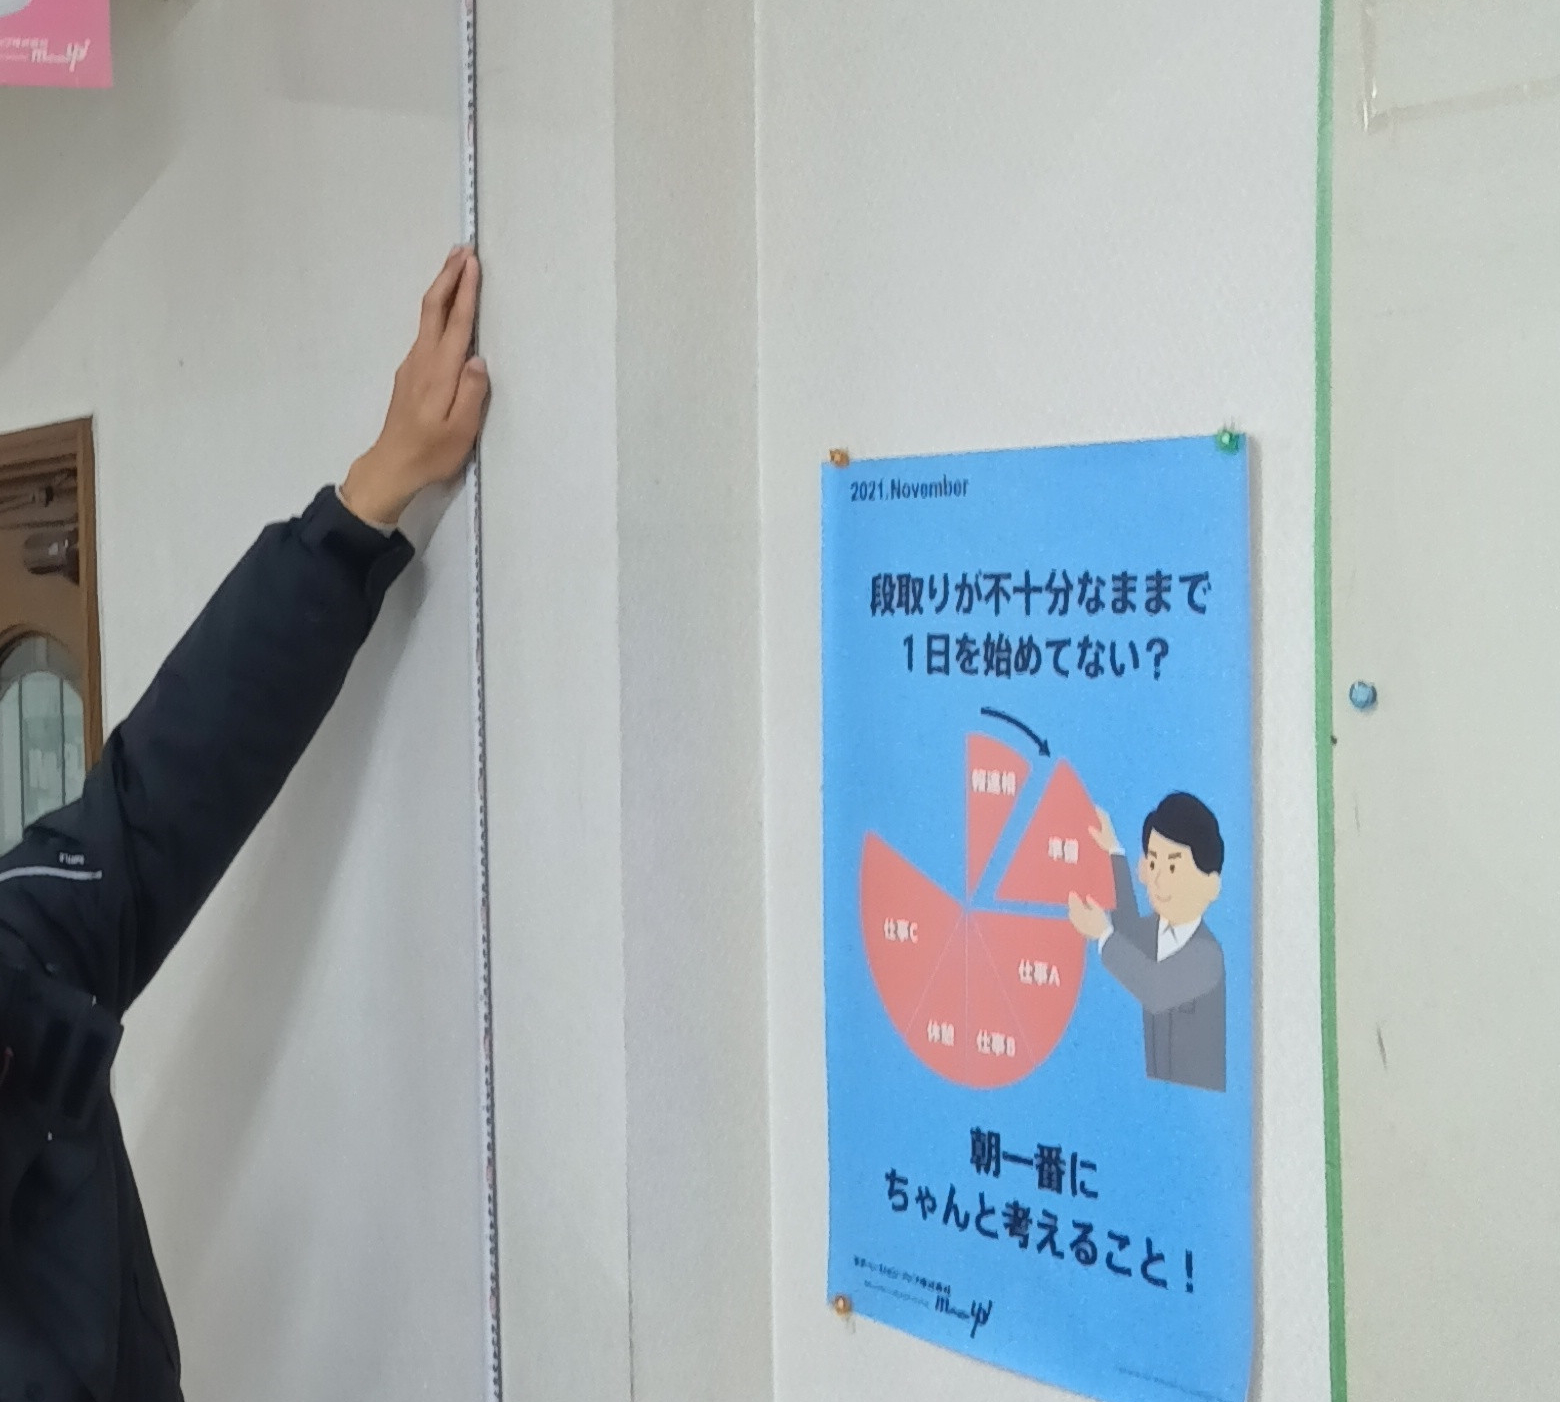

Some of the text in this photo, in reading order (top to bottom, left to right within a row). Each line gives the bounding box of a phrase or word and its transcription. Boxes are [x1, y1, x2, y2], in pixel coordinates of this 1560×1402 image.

[869, 569, 1211, 617] 段取りが不十分なままで
[902, 631, 1169, 680] 1日を始めてない?
[970, 1126, 1099, 1197] 朝一番に
[884, 1168, 1193, 1293] ちゃんと考えること!
